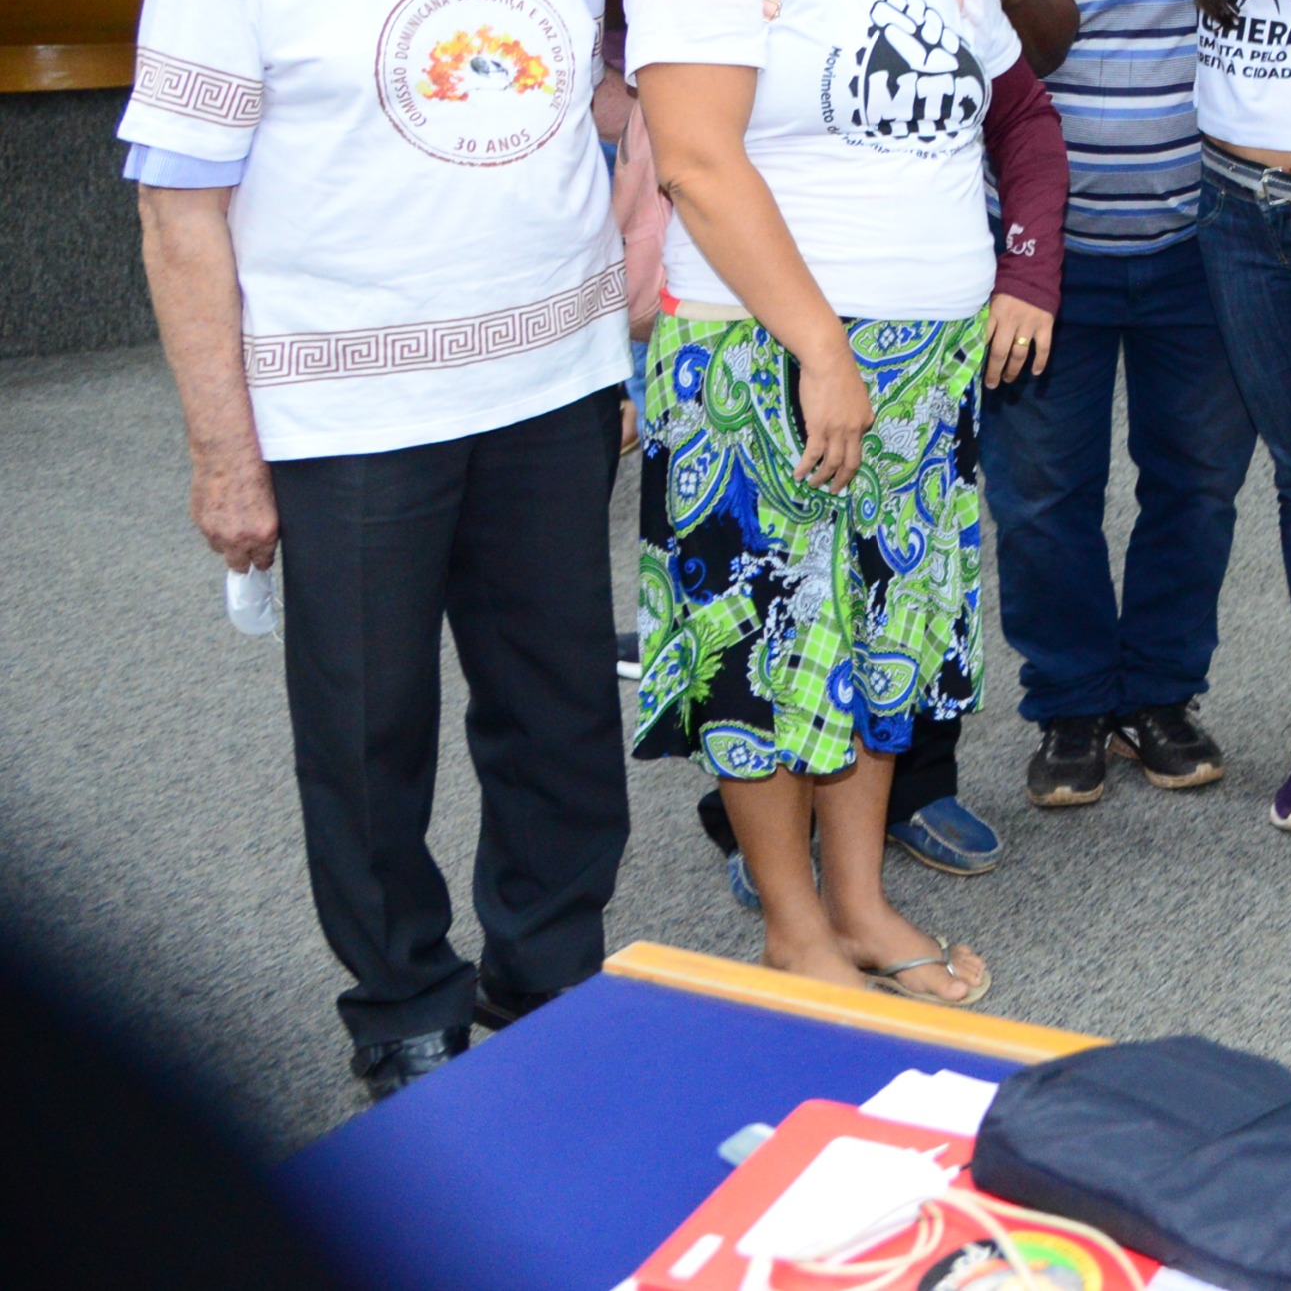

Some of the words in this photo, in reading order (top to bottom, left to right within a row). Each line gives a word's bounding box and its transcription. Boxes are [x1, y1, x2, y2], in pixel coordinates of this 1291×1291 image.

[528, 8, 537, 19] E
[538, 18, 558, 42] PAZ
[551, 45, 563, 63] DO
[1250, 50, 1288, 62] PELO
[390, 66, 427, 127] COMISSÃO
[549, 69, 566, 111] BRASIL
[820, 45, 842, 124] Movimento
[866, 69, 983, 137] MTD
[454, 136, 477, 153] 30
[486, 128, 531, 154] ANOS
